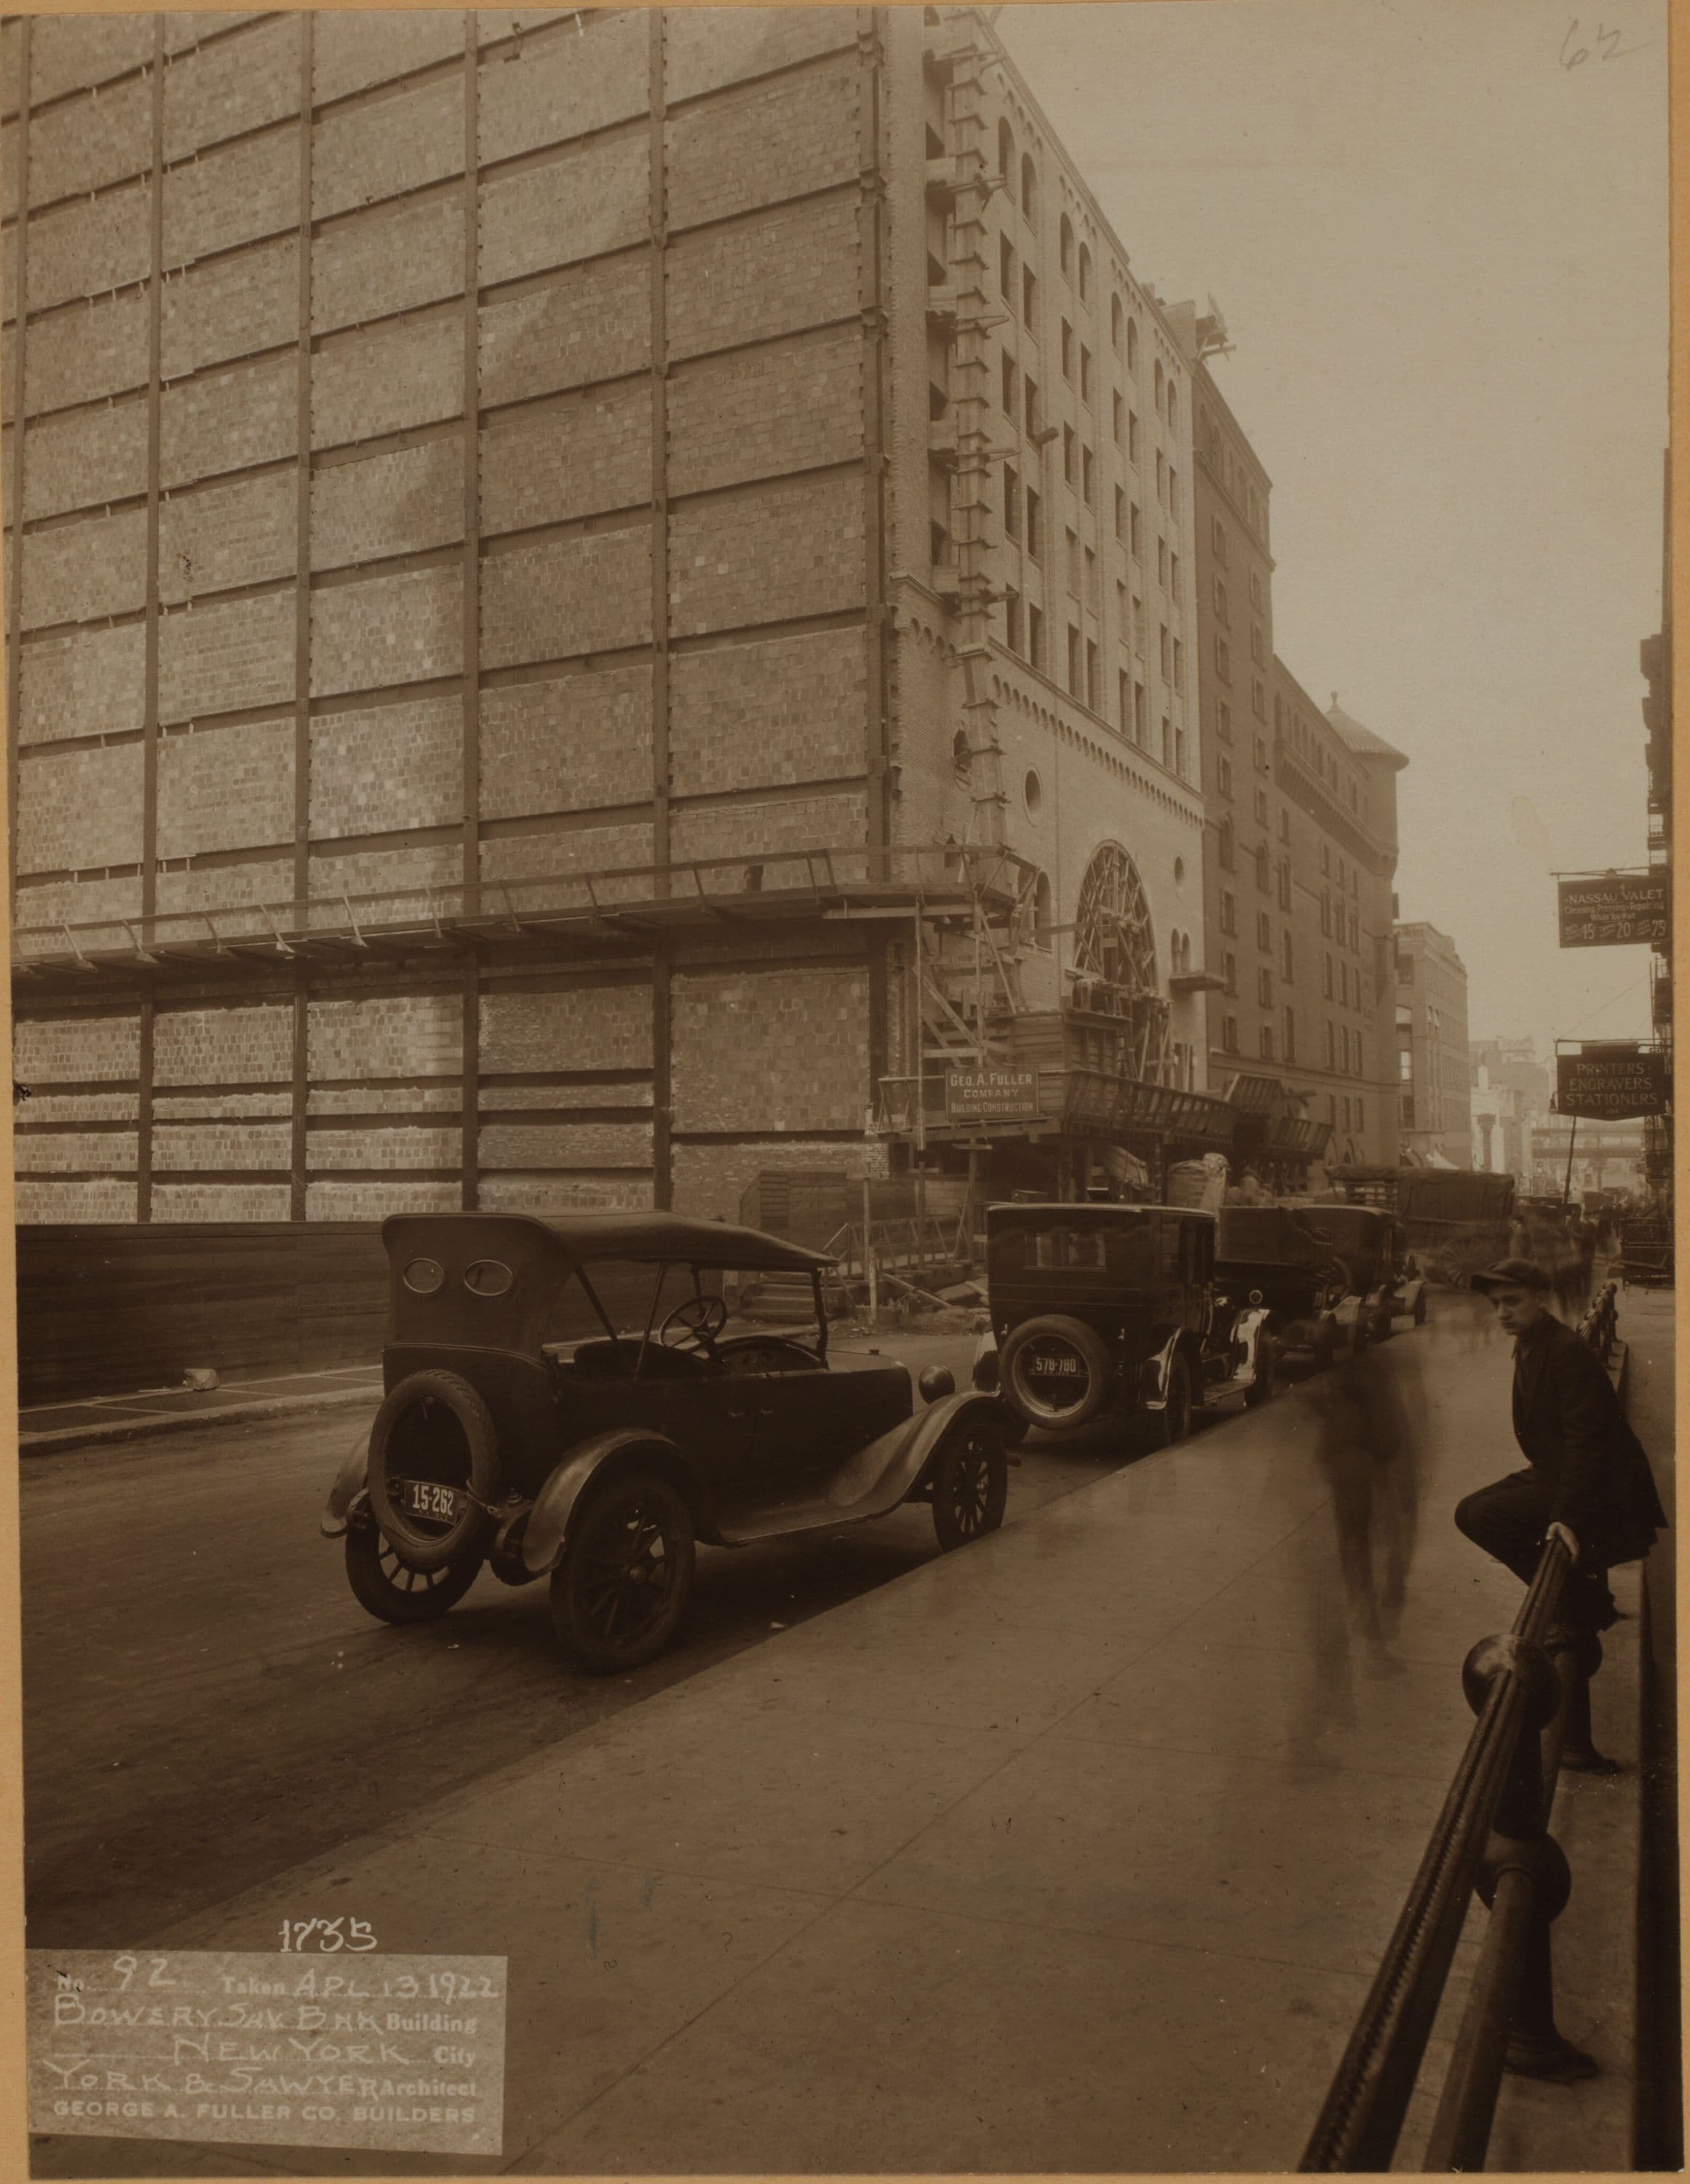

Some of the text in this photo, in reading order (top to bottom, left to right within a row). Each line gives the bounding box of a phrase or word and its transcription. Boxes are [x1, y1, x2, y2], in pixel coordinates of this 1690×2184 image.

[1568, 889, 1664, 905] NASSAU VALET
[1576, 1062, 1644, 1076] PRINTERS
[990, 1073, 1033, 1085] FULLER
[1569, 1077, 1653, 1091] ENGRAVERS
[964, 1089, 1019, 1098] COMPANY
[1566, 1092, 1659, 1106] STATIONERS
[951, 1102, 1034, 1113] BUILDING CONSTRUCTION
